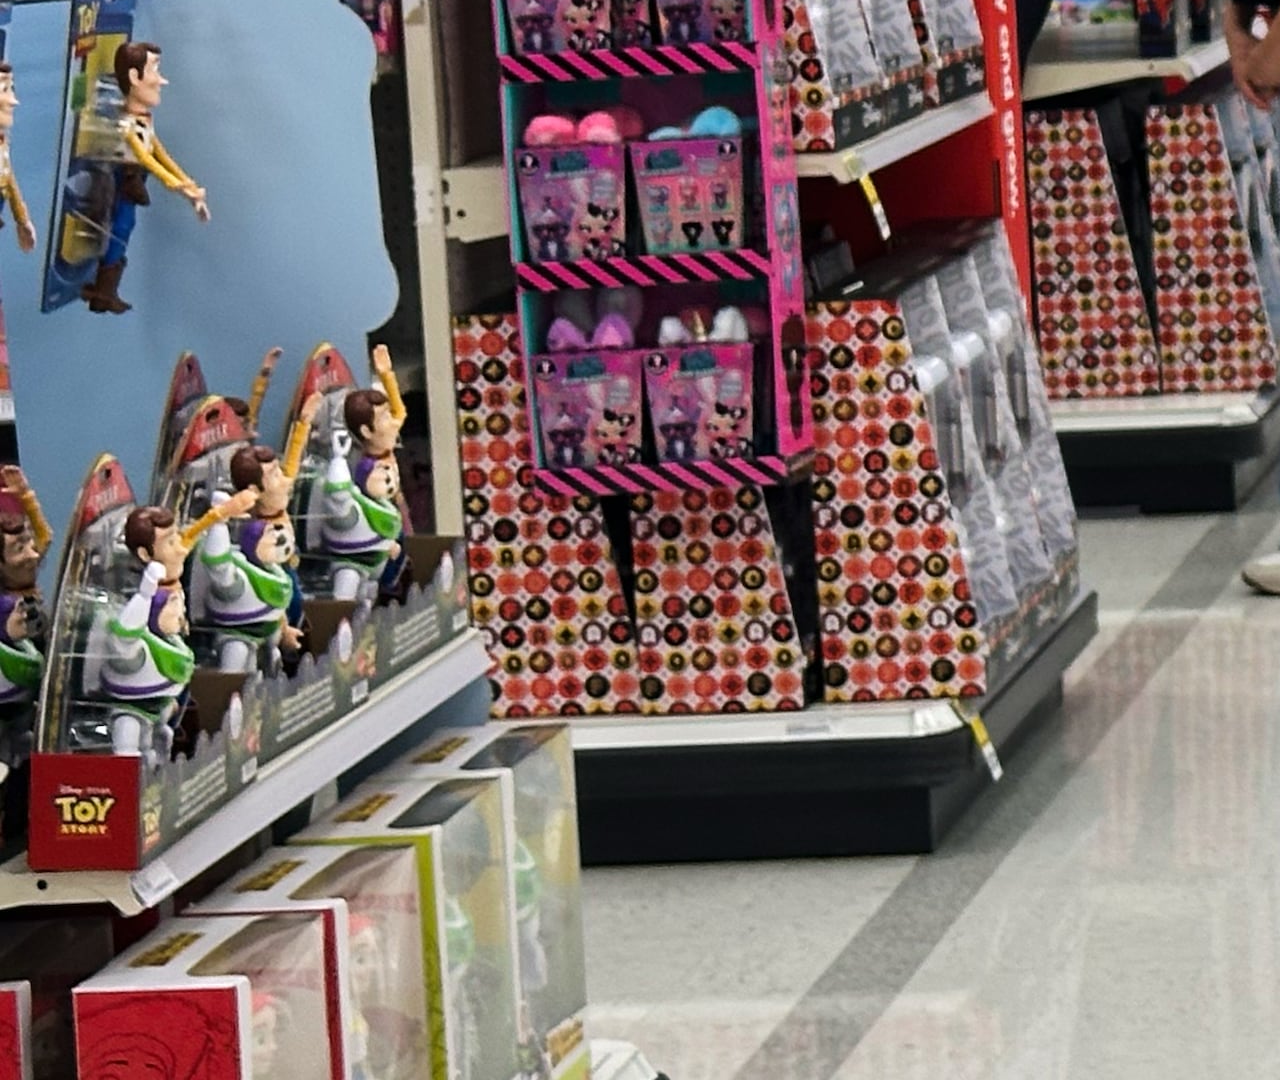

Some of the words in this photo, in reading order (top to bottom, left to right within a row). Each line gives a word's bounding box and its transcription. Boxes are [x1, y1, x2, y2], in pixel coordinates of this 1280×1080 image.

[999, 23, 1015, 101] and
[54, 796, 116, 823] TOY
[60, 823, 108, 835] STORY
